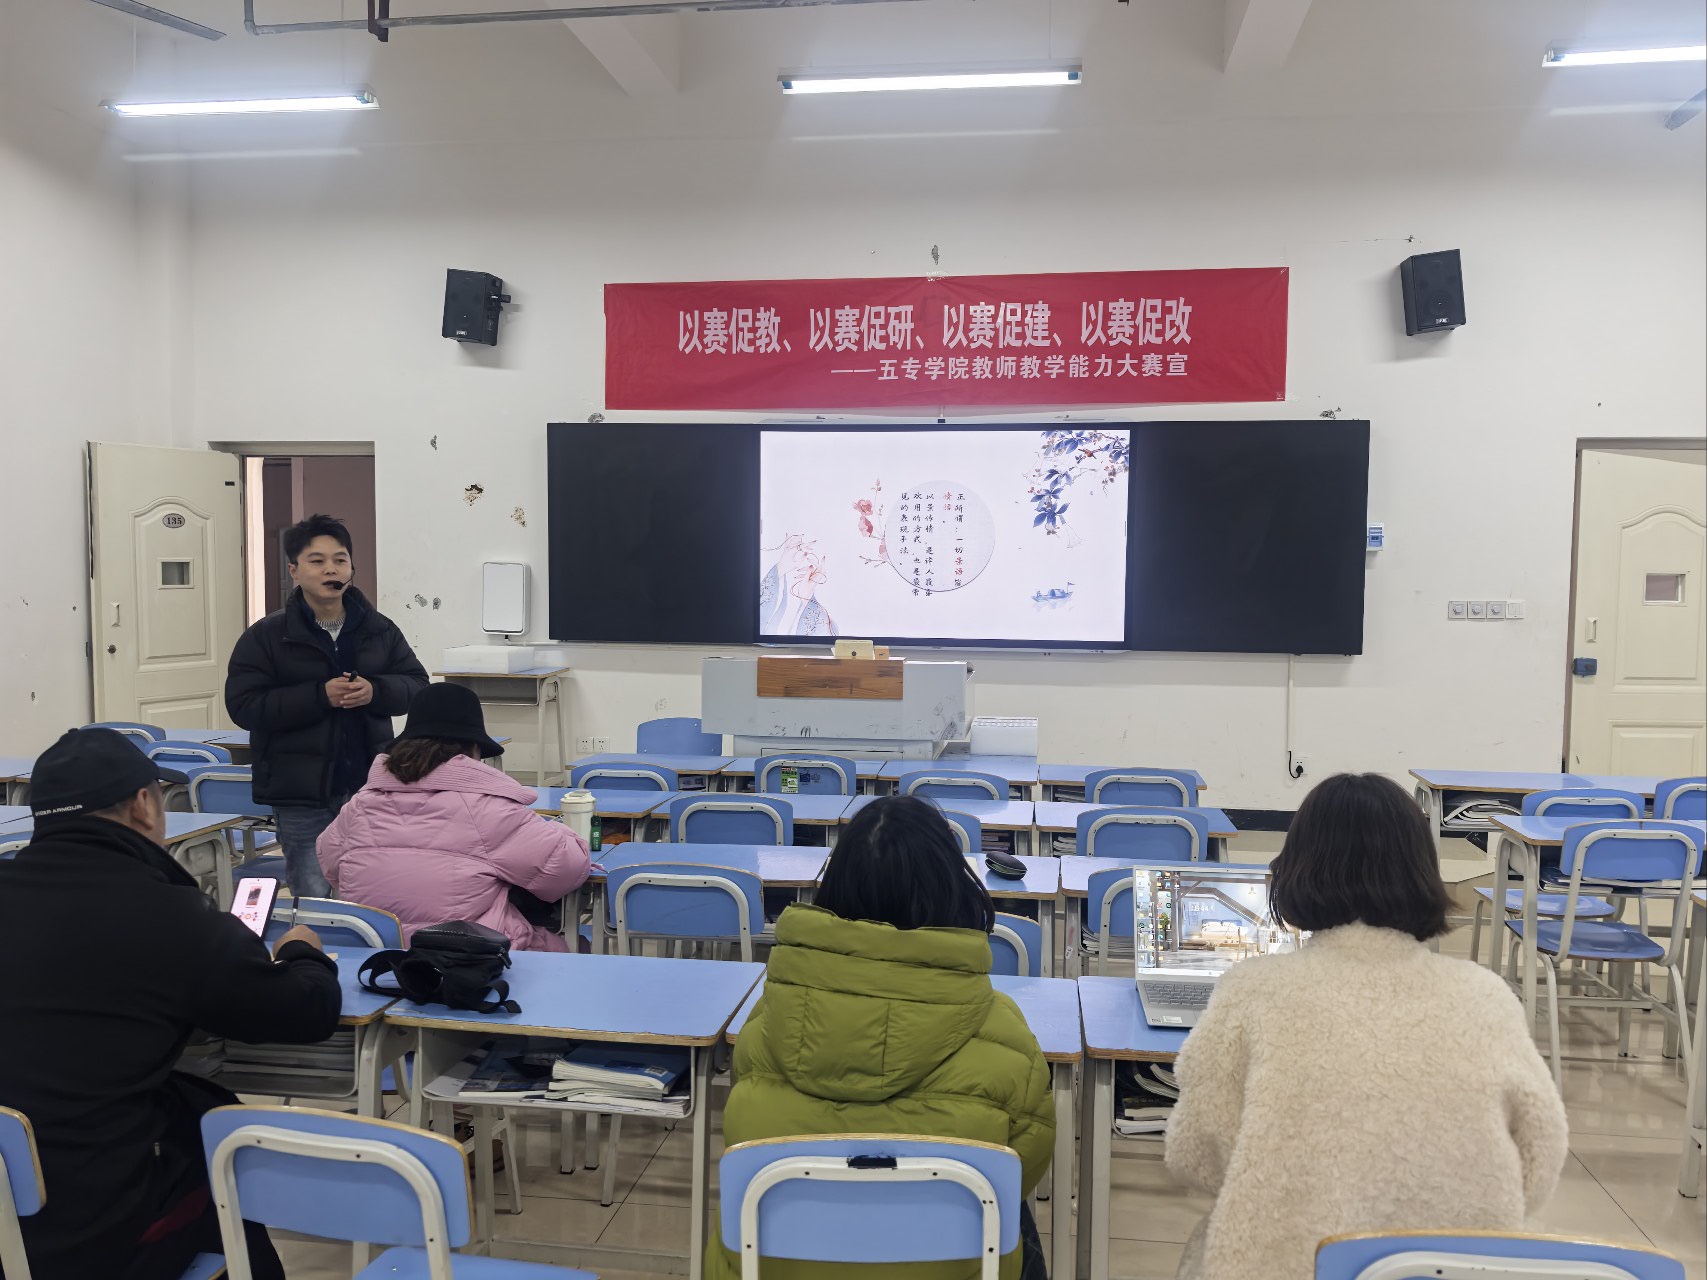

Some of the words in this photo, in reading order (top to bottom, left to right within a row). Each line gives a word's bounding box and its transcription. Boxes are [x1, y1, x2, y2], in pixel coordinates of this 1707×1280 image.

[678, 297, 1193, 354] 以赛促教、以赛促研、以赛促建、以赛促改
